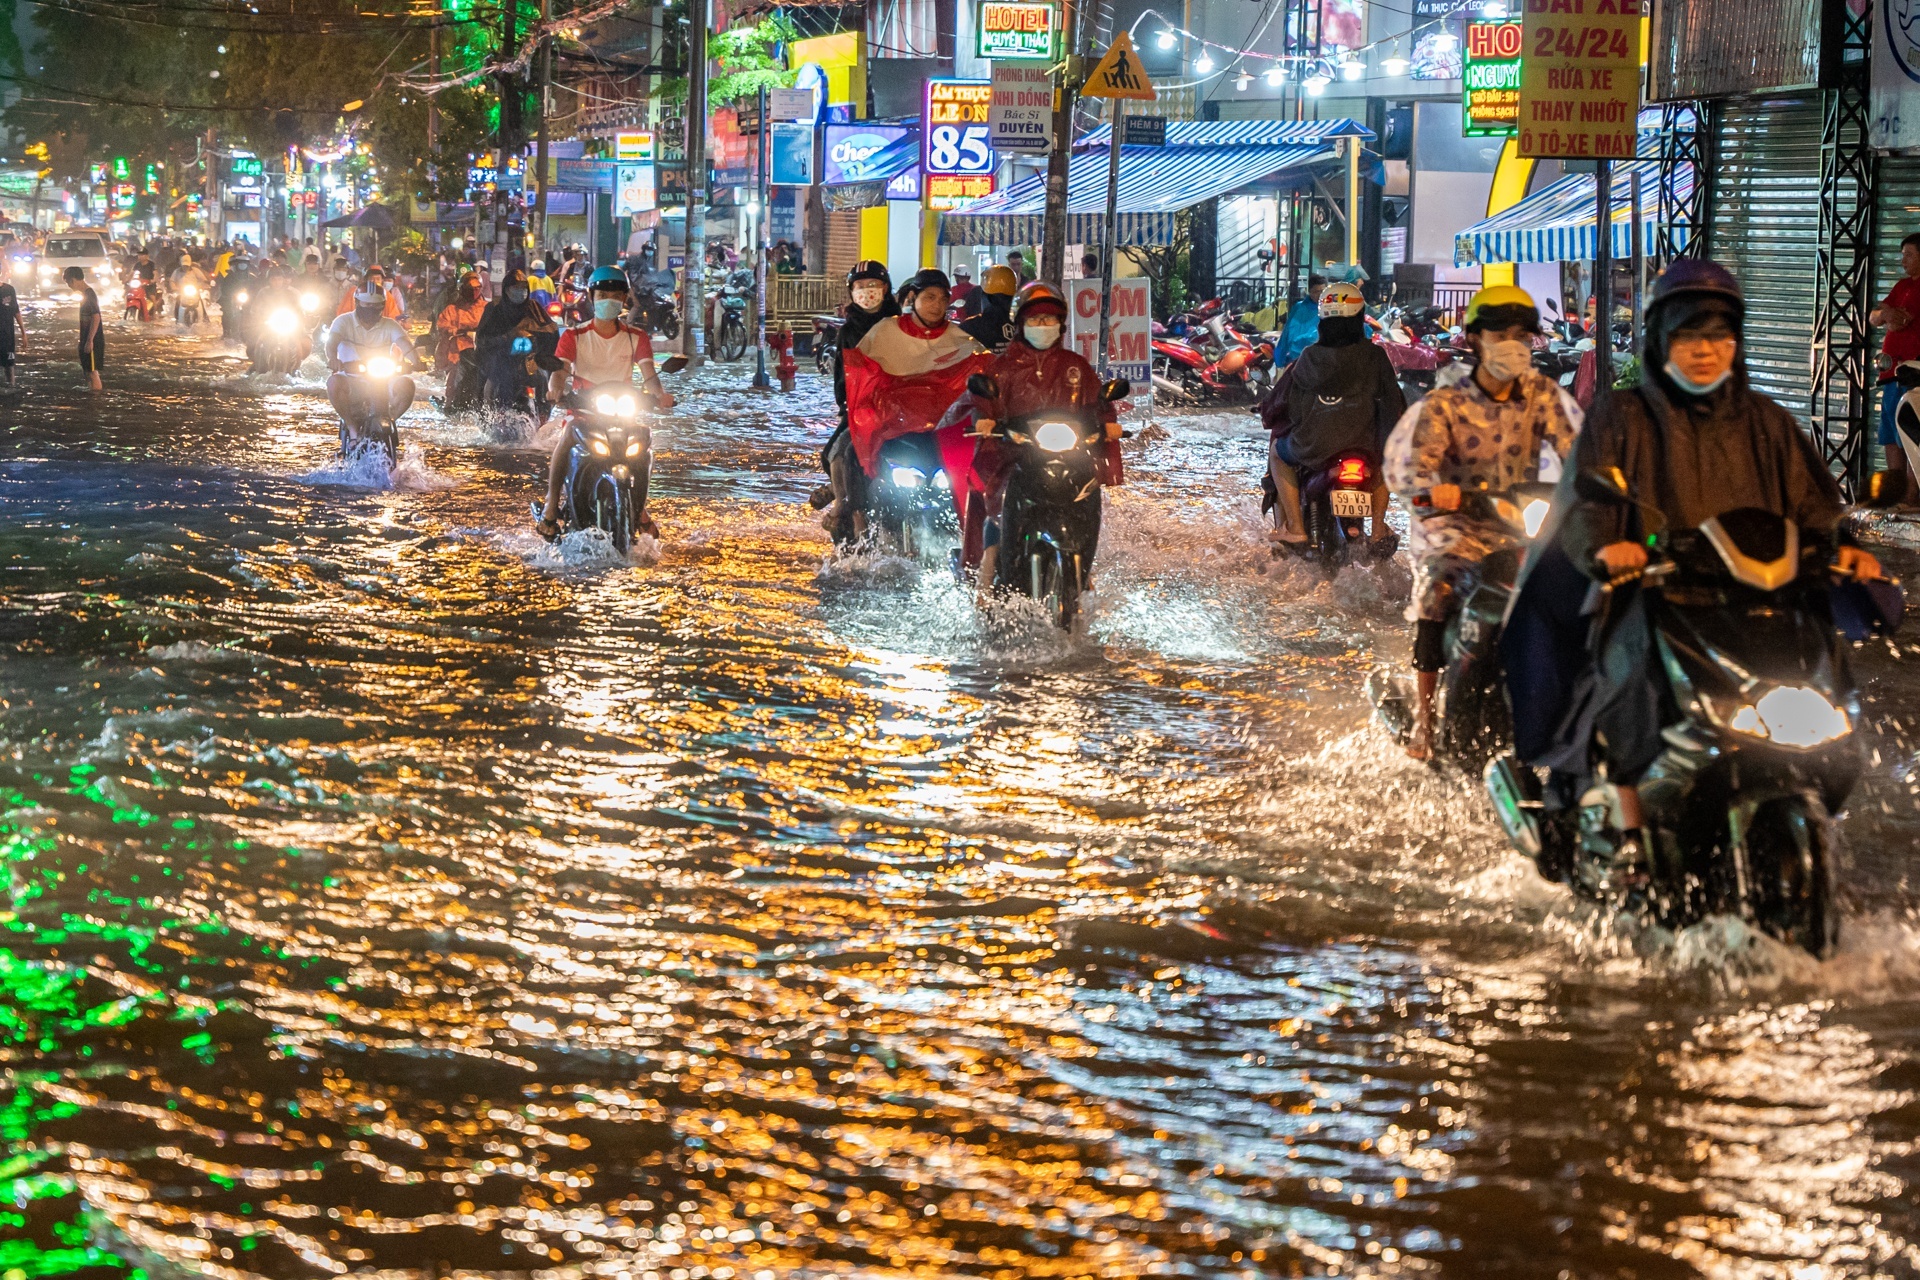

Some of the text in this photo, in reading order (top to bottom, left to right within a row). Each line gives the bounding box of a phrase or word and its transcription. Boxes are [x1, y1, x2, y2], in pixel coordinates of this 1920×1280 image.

[985, 6, 1049, 31] HOTEL
[1534, 26, 1629, 58] 24/24
[1548, 62, 1613, 90] RỬA XE
[994, 91, 1014, 106] NHI
[1531, 98, 1628, 123] THAY NHỚT
[932, 103, 990, 122] LEON
[999, 121, 1044, 134] DUYÊN
[1153, 121, 1164, 130] 91
[931, 126, 989, 169] 85
[1521, 128, 1635, 156] Ô TÔ-XE MÁY
